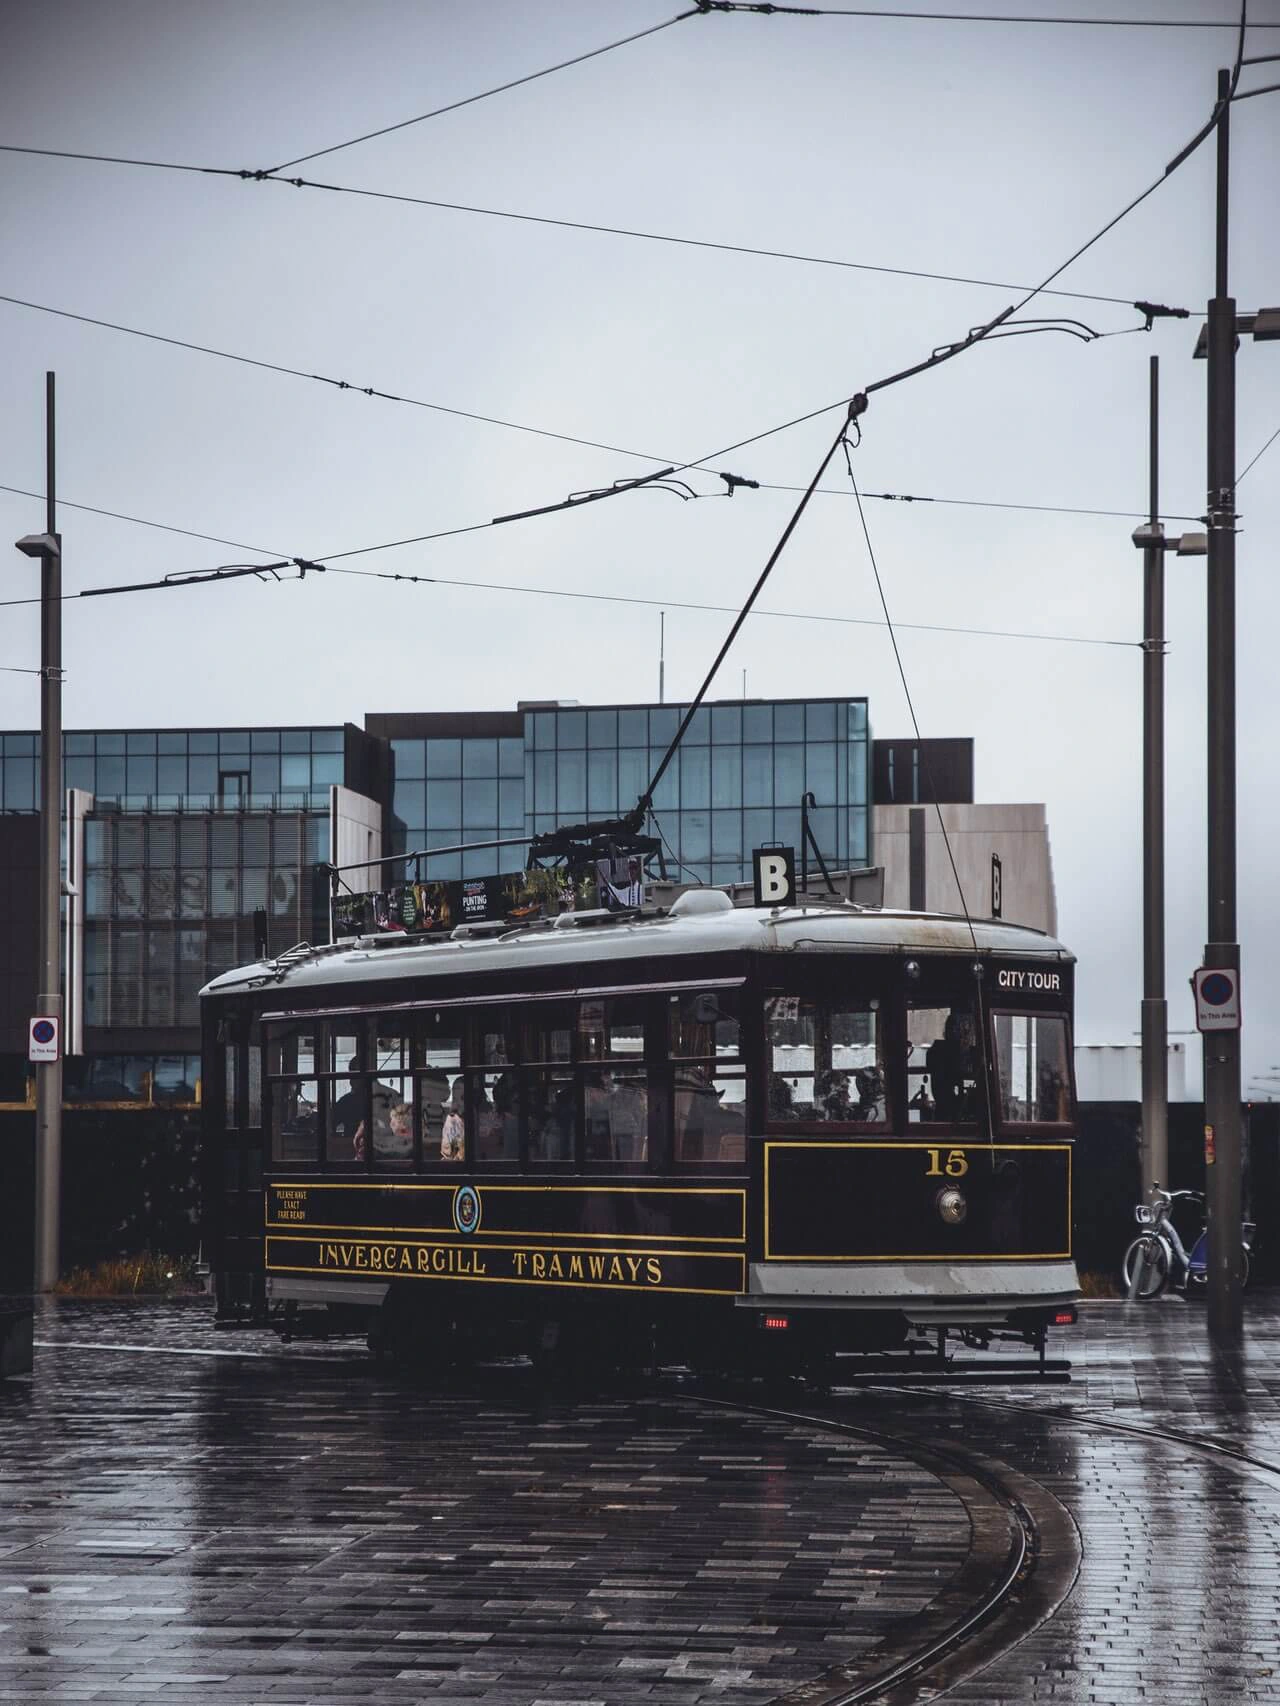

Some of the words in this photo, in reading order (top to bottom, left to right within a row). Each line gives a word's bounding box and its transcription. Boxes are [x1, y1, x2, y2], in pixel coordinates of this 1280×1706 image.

[760, 855, 789, 902] B
[462, 895, 487, 907] PUNTING
[998, 970, 1025, 987] CITY
[1027, 972, 1060, 990] TOUR
[925, 1149, 968, 1177] 15
[319, 1244, 486, 1274] INVERCARGILL
[512, 1252, 662, 1284] TRAMWAYS
